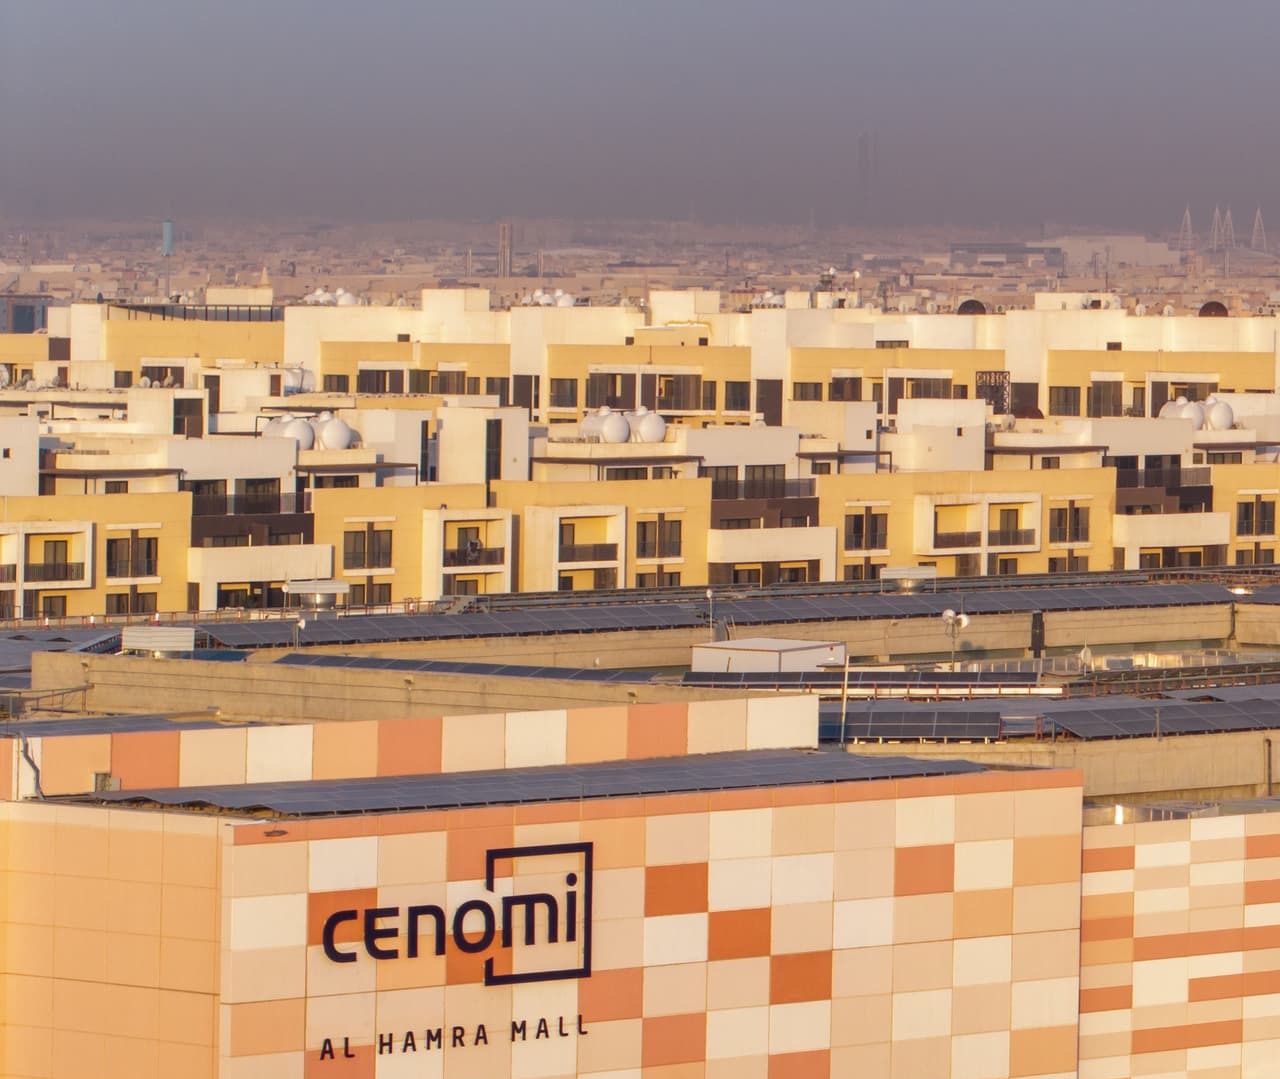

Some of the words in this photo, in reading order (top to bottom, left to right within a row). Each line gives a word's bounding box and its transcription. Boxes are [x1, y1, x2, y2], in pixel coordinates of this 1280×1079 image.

[320, 1037, 355, 1060] AL
[378, 1023, 488, 1055] HAMRA
[511, 1014, 588, 1042] MALL
